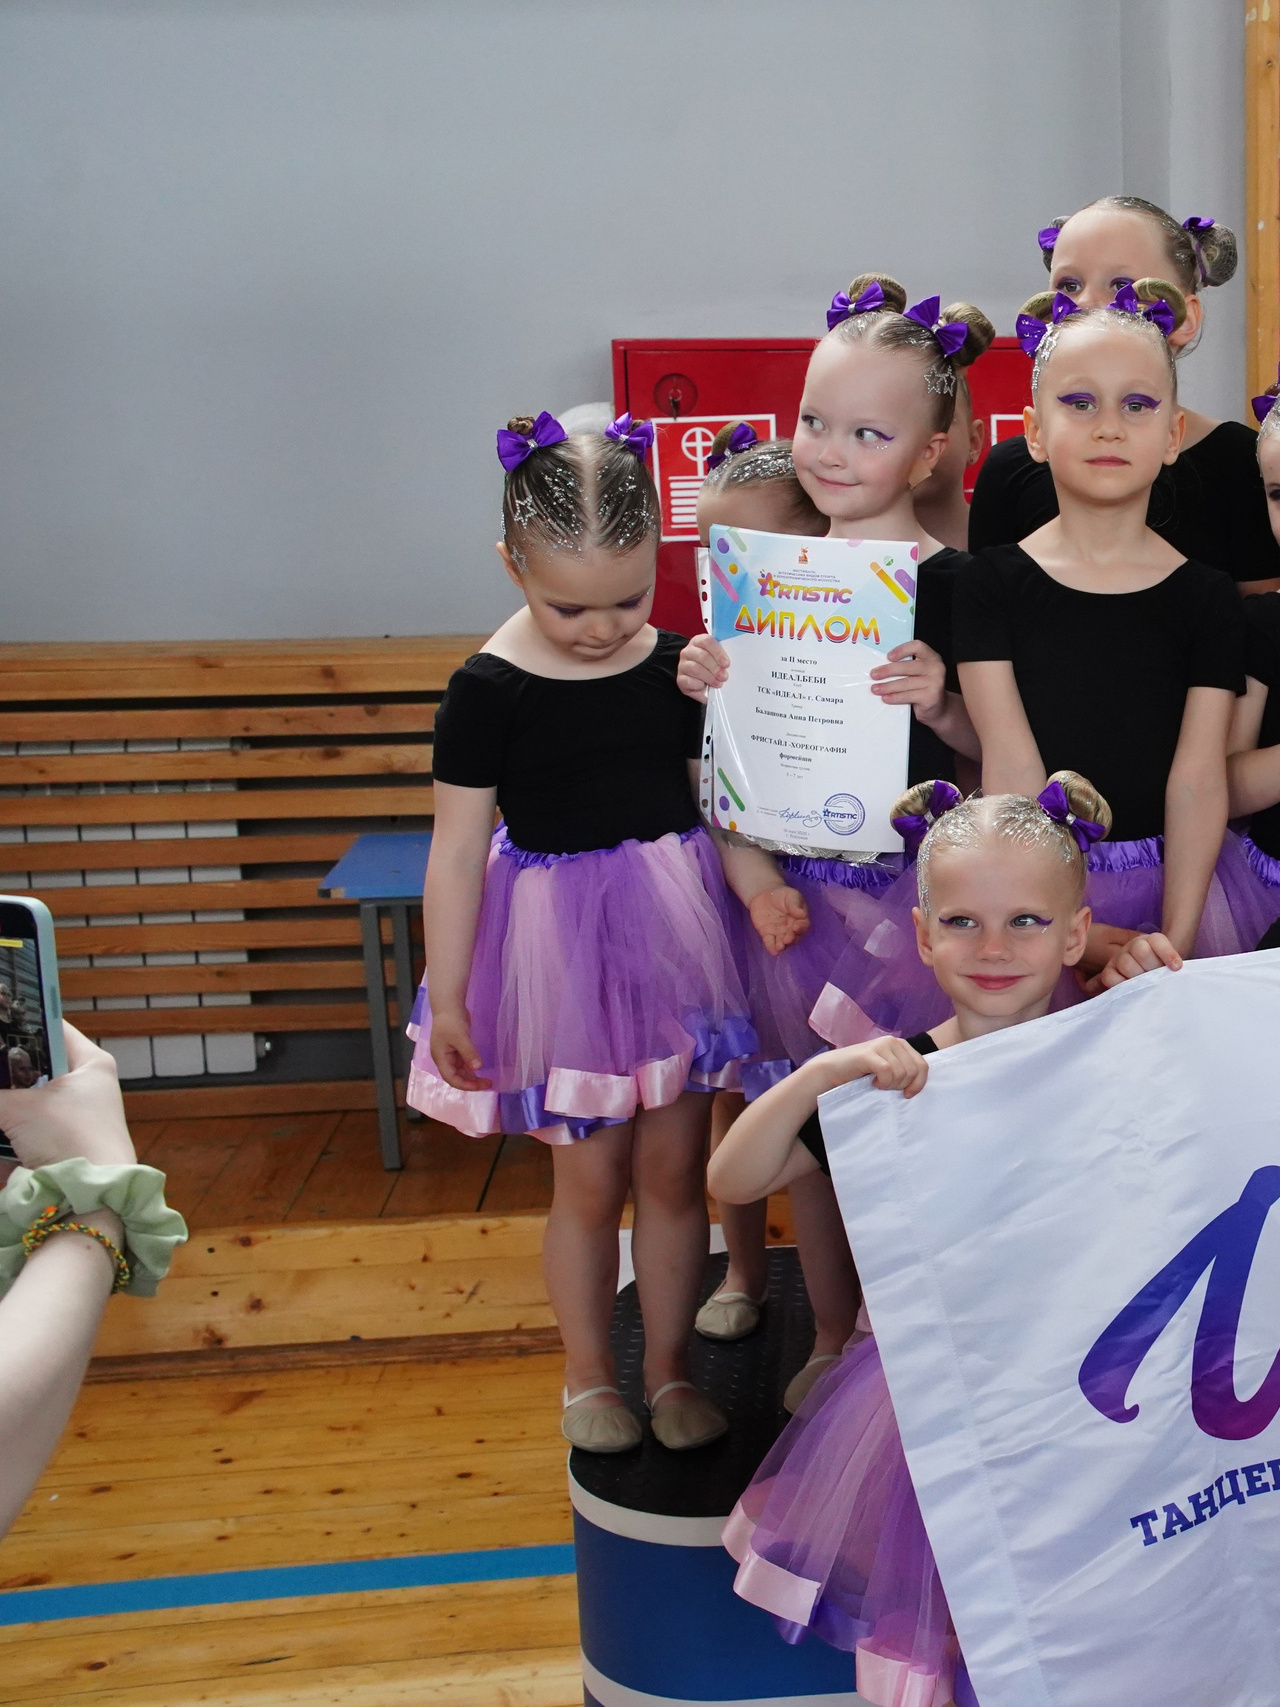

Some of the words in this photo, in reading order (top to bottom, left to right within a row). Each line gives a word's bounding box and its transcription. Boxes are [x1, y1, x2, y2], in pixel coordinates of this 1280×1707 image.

[757, 572, 853, 604] ARTISTIC
[734, 605, 881, 645] ДИПЛОМ
[797, 658, 818, 666] место
[757, 686, 771, 695] ТСК
[771, 689, 807, 701] «ИДЕАЛ»
[815, 695, 844, 705] Самара
[755, 707, 787, 719] Балашова
[788, 713, 807, 722] Анна
[808, 716, 844, 726] Петровна
[822, 808, 858, 820] ARTISTIC
